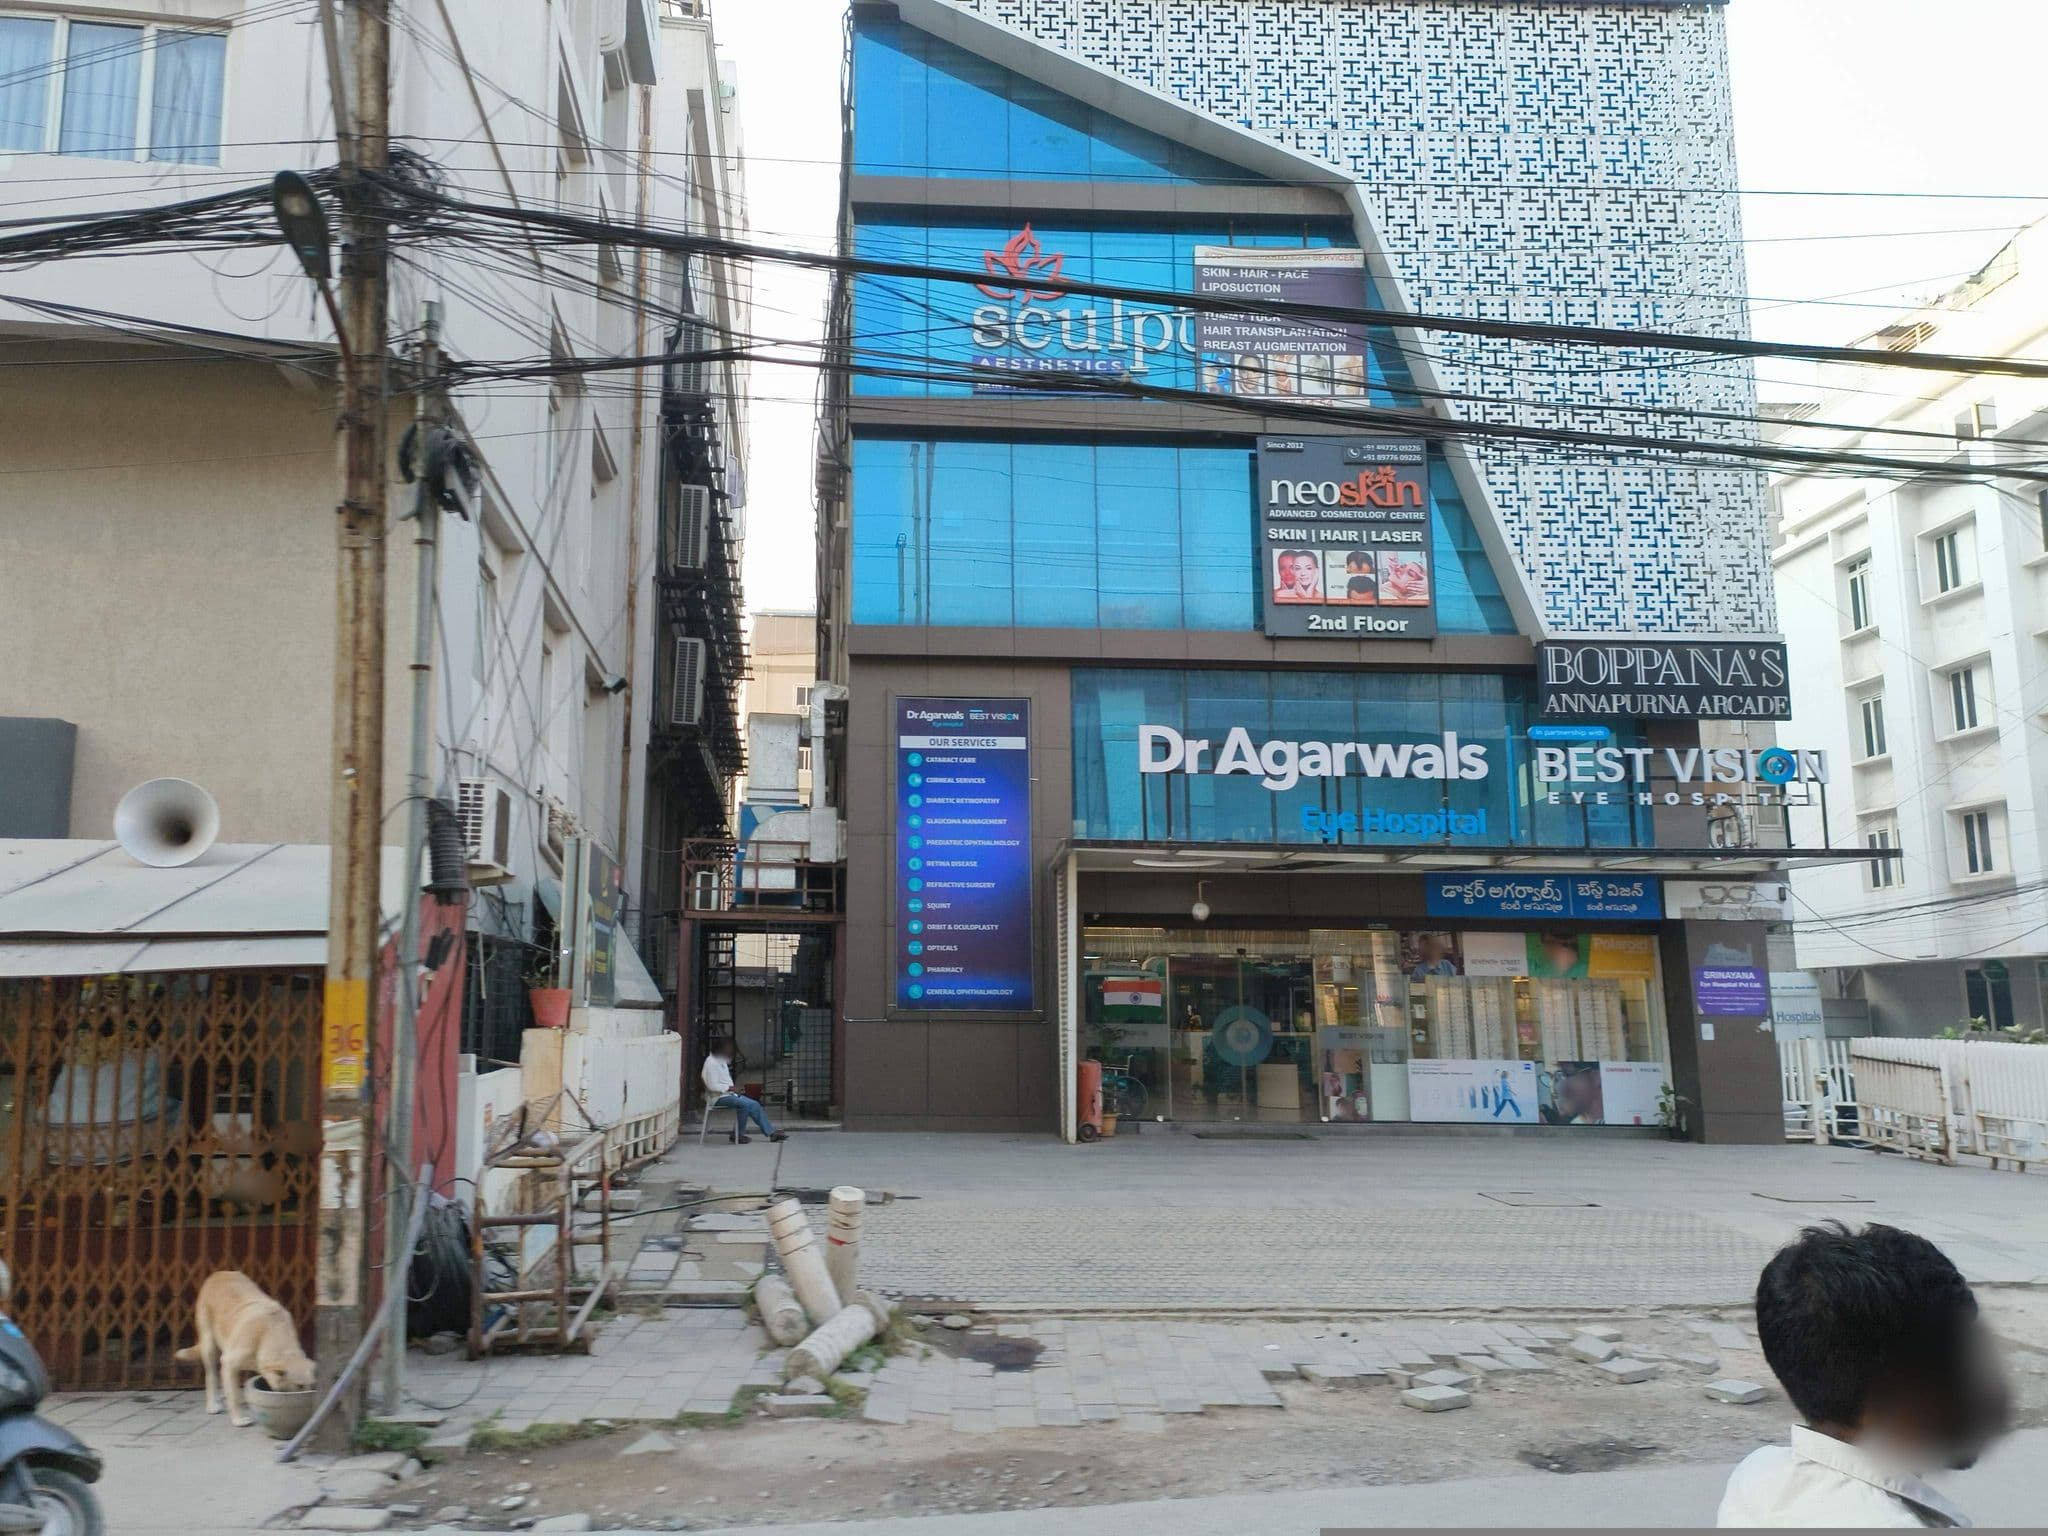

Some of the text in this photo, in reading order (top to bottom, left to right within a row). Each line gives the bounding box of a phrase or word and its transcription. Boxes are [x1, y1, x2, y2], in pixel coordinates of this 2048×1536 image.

[1202, 267, 1231, 278] SKIN
[1239, 268, 1269, 279] HAIR
[1278, 269, 1309, 280] FACE
[1202, 282, 1281, 293] LIPOSUCTION
[1203, 325, 1232, 336] HAIR
[1203, 340, 1347, 352] BREAST AUGMENTATION
[1266, 441, 1304, 449] Since 2012
[1269, 468, 1424, 508] neoskin
[1269, 509, 1426, 520] ADVANCED COSMETOLOGY CENTRE
[1267, 528, 1308, 541] SKIN
[1319, 530, 1359, 542] HAIR
[1371, 530, 1424, 543] LASER
[1307, 613, 1409, 633] 2nd Floor
[1545, 645, 1786, 688] BOPPANA'S
[1545, 692, 1790, 716] ANNAPURNA ARCADE
[929, 738, 998, 748] OUR SERVICES
[1138, 724, 1490, 791] Dr Agarwals
[1537, 747, 1829, 785] BEST VISION
[1549, 790, 1610, 805] EYE
[1301, 805, 1487, 841] Eye Hospital
[1776, 1010, 1822, 1026] Hospitals
